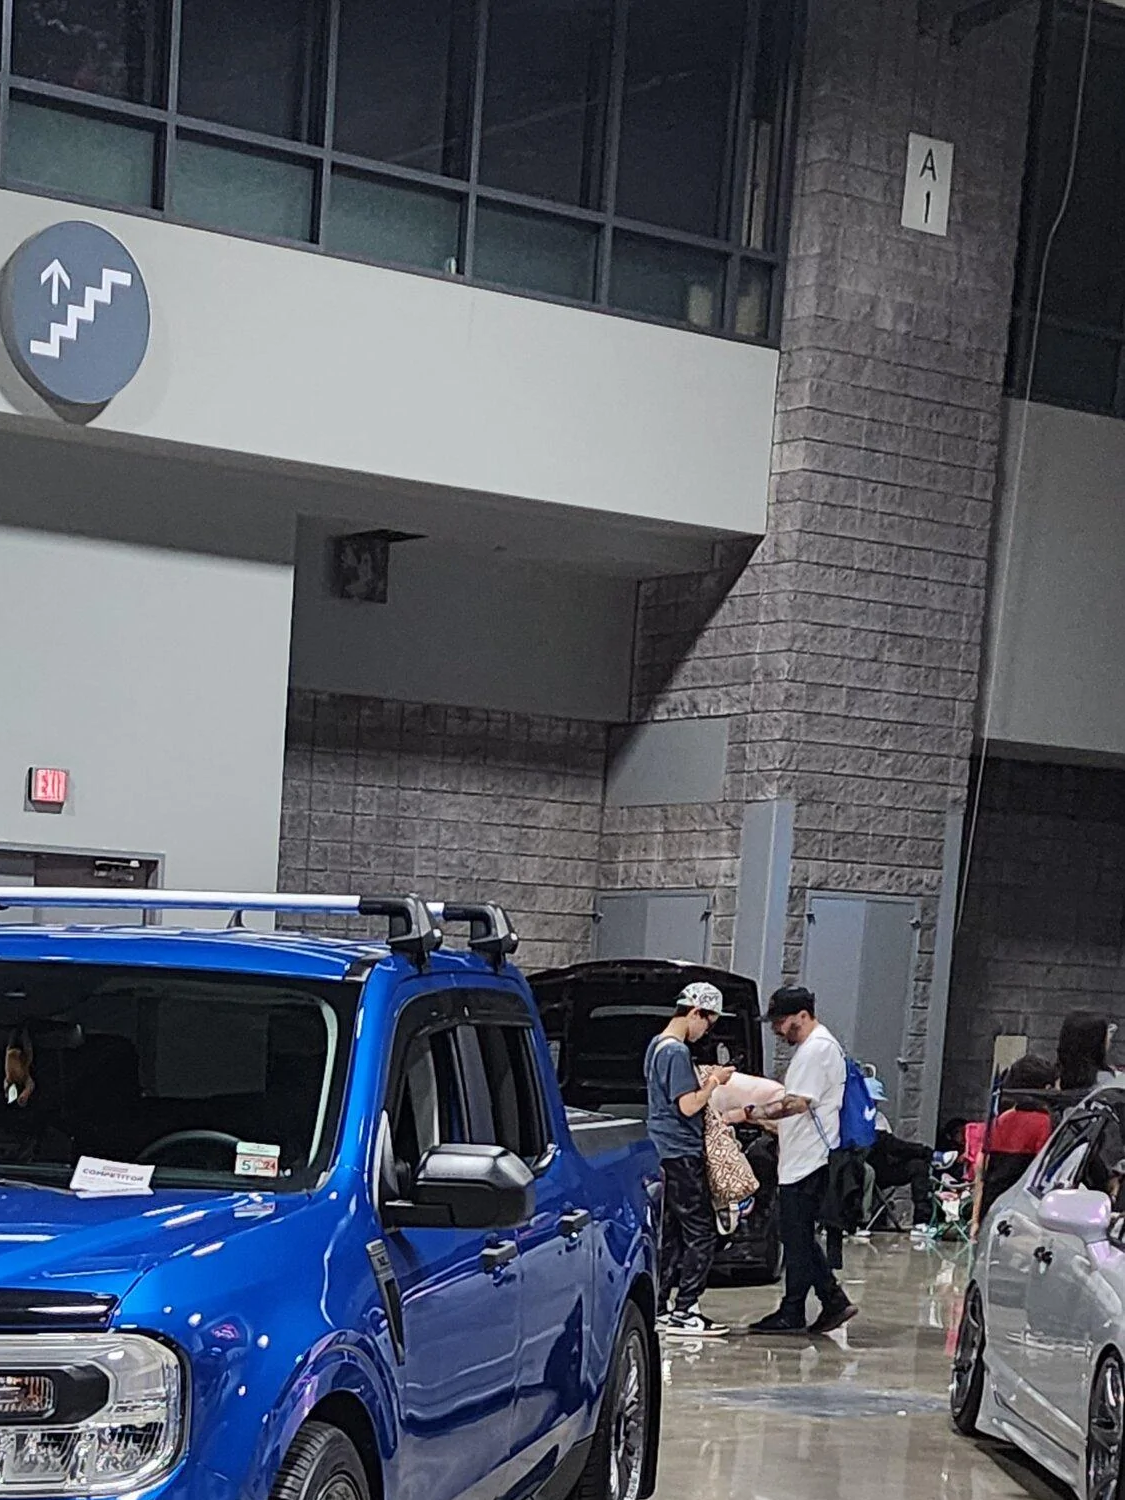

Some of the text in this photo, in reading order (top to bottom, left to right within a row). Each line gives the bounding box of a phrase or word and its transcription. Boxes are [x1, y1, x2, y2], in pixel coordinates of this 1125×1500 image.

[919, 148, 937, 182] A
[36, 769, 66, 801] EXIT
[82, 1167, 144, 1181] COMPETITOR
[242, 1159, 251, 1171] 5
